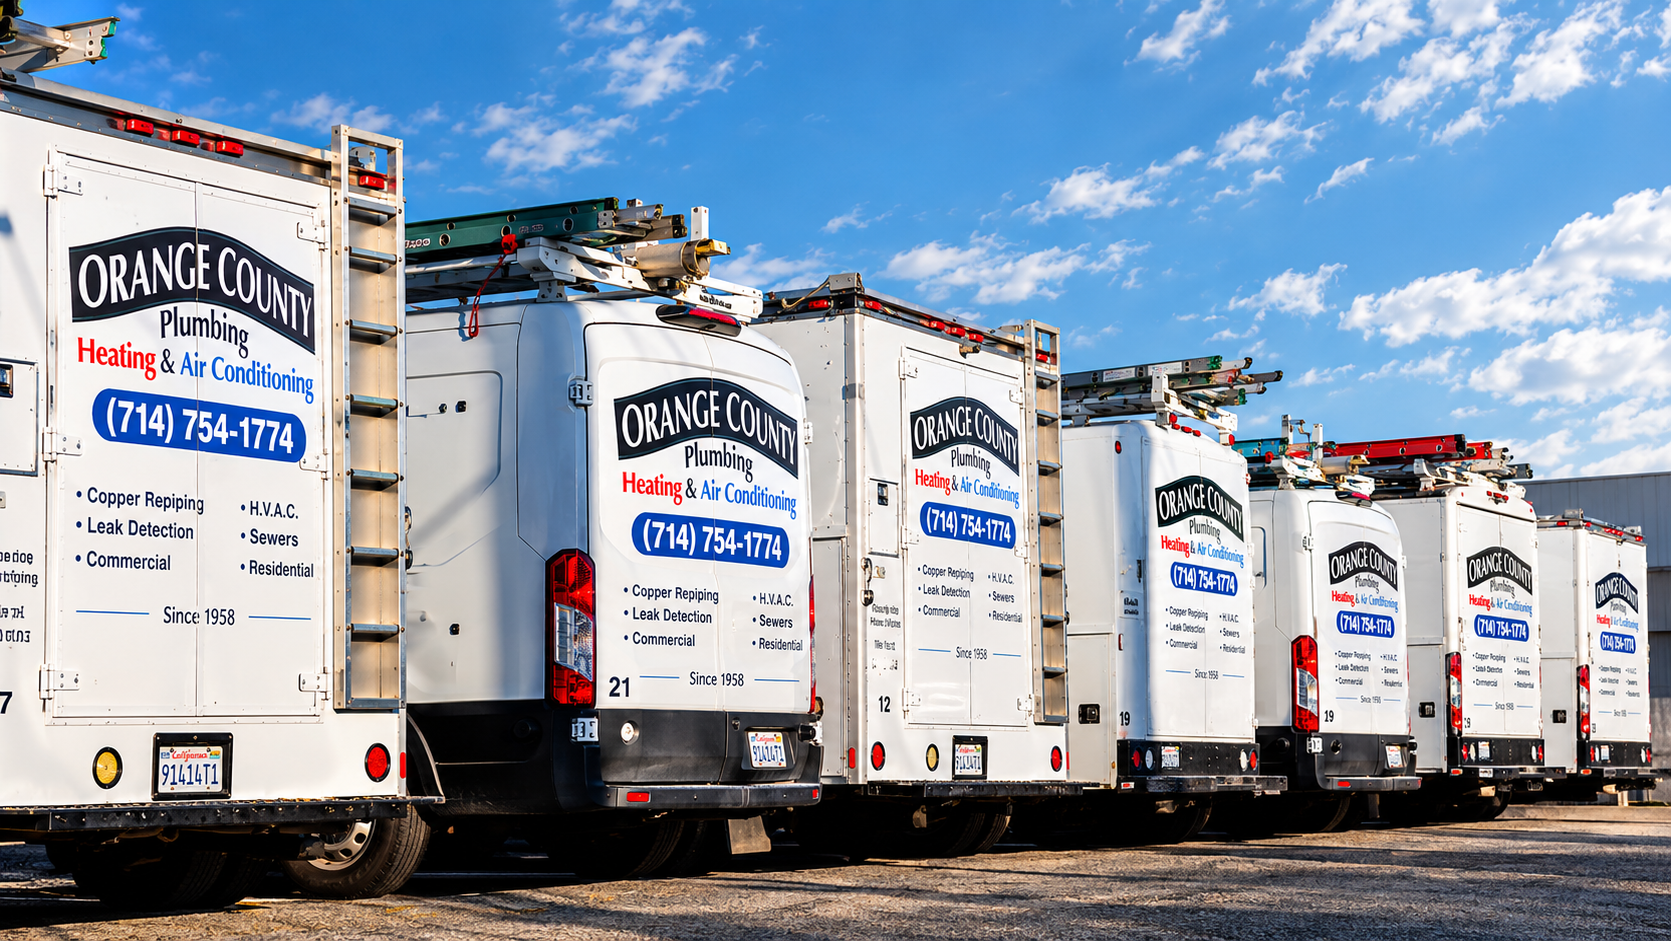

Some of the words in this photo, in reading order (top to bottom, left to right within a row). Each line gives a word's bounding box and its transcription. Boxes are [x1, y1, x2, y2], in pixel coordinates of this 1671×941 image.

[78, 241, 210, 308] ORANGE
[218, 246, 312, 338] COUNTY
[160, 305, 249, 358] Plumbing
[77, 337, 156, 381] Heating
[160, 348, 175, 374] &
[180, 351, 207, 379] Air
[211, 356, 314, 404] Conditioning
[106, 396, 173, 444] (714)
[182, 409, 294, 454] 754-1774
[621, 390, 720, 448] ORANGE
[726, 391, 796, 466] COUNTY
[914, 406, 972, 450] ORANGE
[974, 408, 1018, 465] COUNTY
[684, 441, 753, 483] Plumbing
[951, 447, 991, 480] Plumbing
[622, 471, 682, 506] Heating
[685, 478, 697, 499] &
[700, 479, 721, 501] Air
[725, 483, 797, 520] Conditioning
[915, 468, 950, 496] Heating
[952, 475, 958, 491] &
[960, 476, 971, 493] Air
[974, 479, 1019, 509] Conditioning
[87, 487, 141, 508] Copper
[145, 491, 204, 515] Repiping
[250, 501, 298, 519] H.V.A.C.
[1159, 484, 1206, 520] ORANGE
[1207, 486, 1242, 534] COUNTY
[87, 517, 124, 536] Leak
[128, 520, 194, 540] Detection
[926, 506, 957, 537] (714)
[961, 514, 1011, 543] 754-1774
[1189, 518, 1221, 545] Plumbing
[250, 529, 298, 546] Sewers
[643, 518, 697, 556] (714)
[702, 525, 782, 560] 754-1774
[1161, 535, 1190, 558] Heating
[1197, 542, 1206, 555] Air
[87, 551, 171, 571] Commercial
[249, 560, 314, 578] Residential
[922, 564, 946, 578] Copper
[1331, 547, 1368, 579] ORANGE
[1370, 548, 1397, 585] COUNTY
[1469, 553, 1502, 582] ORANGE
[1504, 553, 1531, 589] COUNTY
[992, 572, 1014, 585] H.V.A.C.
[1173, 565, 1196, 589] (714)
[1198, 570, 1235, 593] 754-1774
[632, 584, 672, 600] Copper
[675, 587, 719, 605] Repiping
[759, 593, 794, 607] H.V.A.C.
[923, 585, 939, 596] Leak
[941, 586, 970, 598] Detection
[992, 591, 1014, 603] Sewers
[163, 606, 199, 625] Since
[204, 608, 235, 626] 1958
[633, 607, 659, 622] Leak
[663, 609, 712, 623] Detection
[759, 614, 793, 628] Sewers
[923, 605, 960, 618] Commercial
[992, 610, 1022, 623] Residential
[1340, 613, 1360, 633] (714)
[1361, 617, 1391, 635] 754-1774
[1477, 617, 1495, 636] (714)
[633, 632, 695, 646] Commercial
[759, 638, 803, 651] Residential
[956, 647, 972, 659] Since
[973, 648, 988, 660] 1958
[609, 676, 630, 698] 21
[689, 671, 717, 686] Since
[720, 673, 744, 687] 1958
[878, 695, 891, 713] 12
[1119, 711, 1130, 726] 19
[1324, 710, 1335, 722] 19
[162, 763, 219, 786] 91414T1
